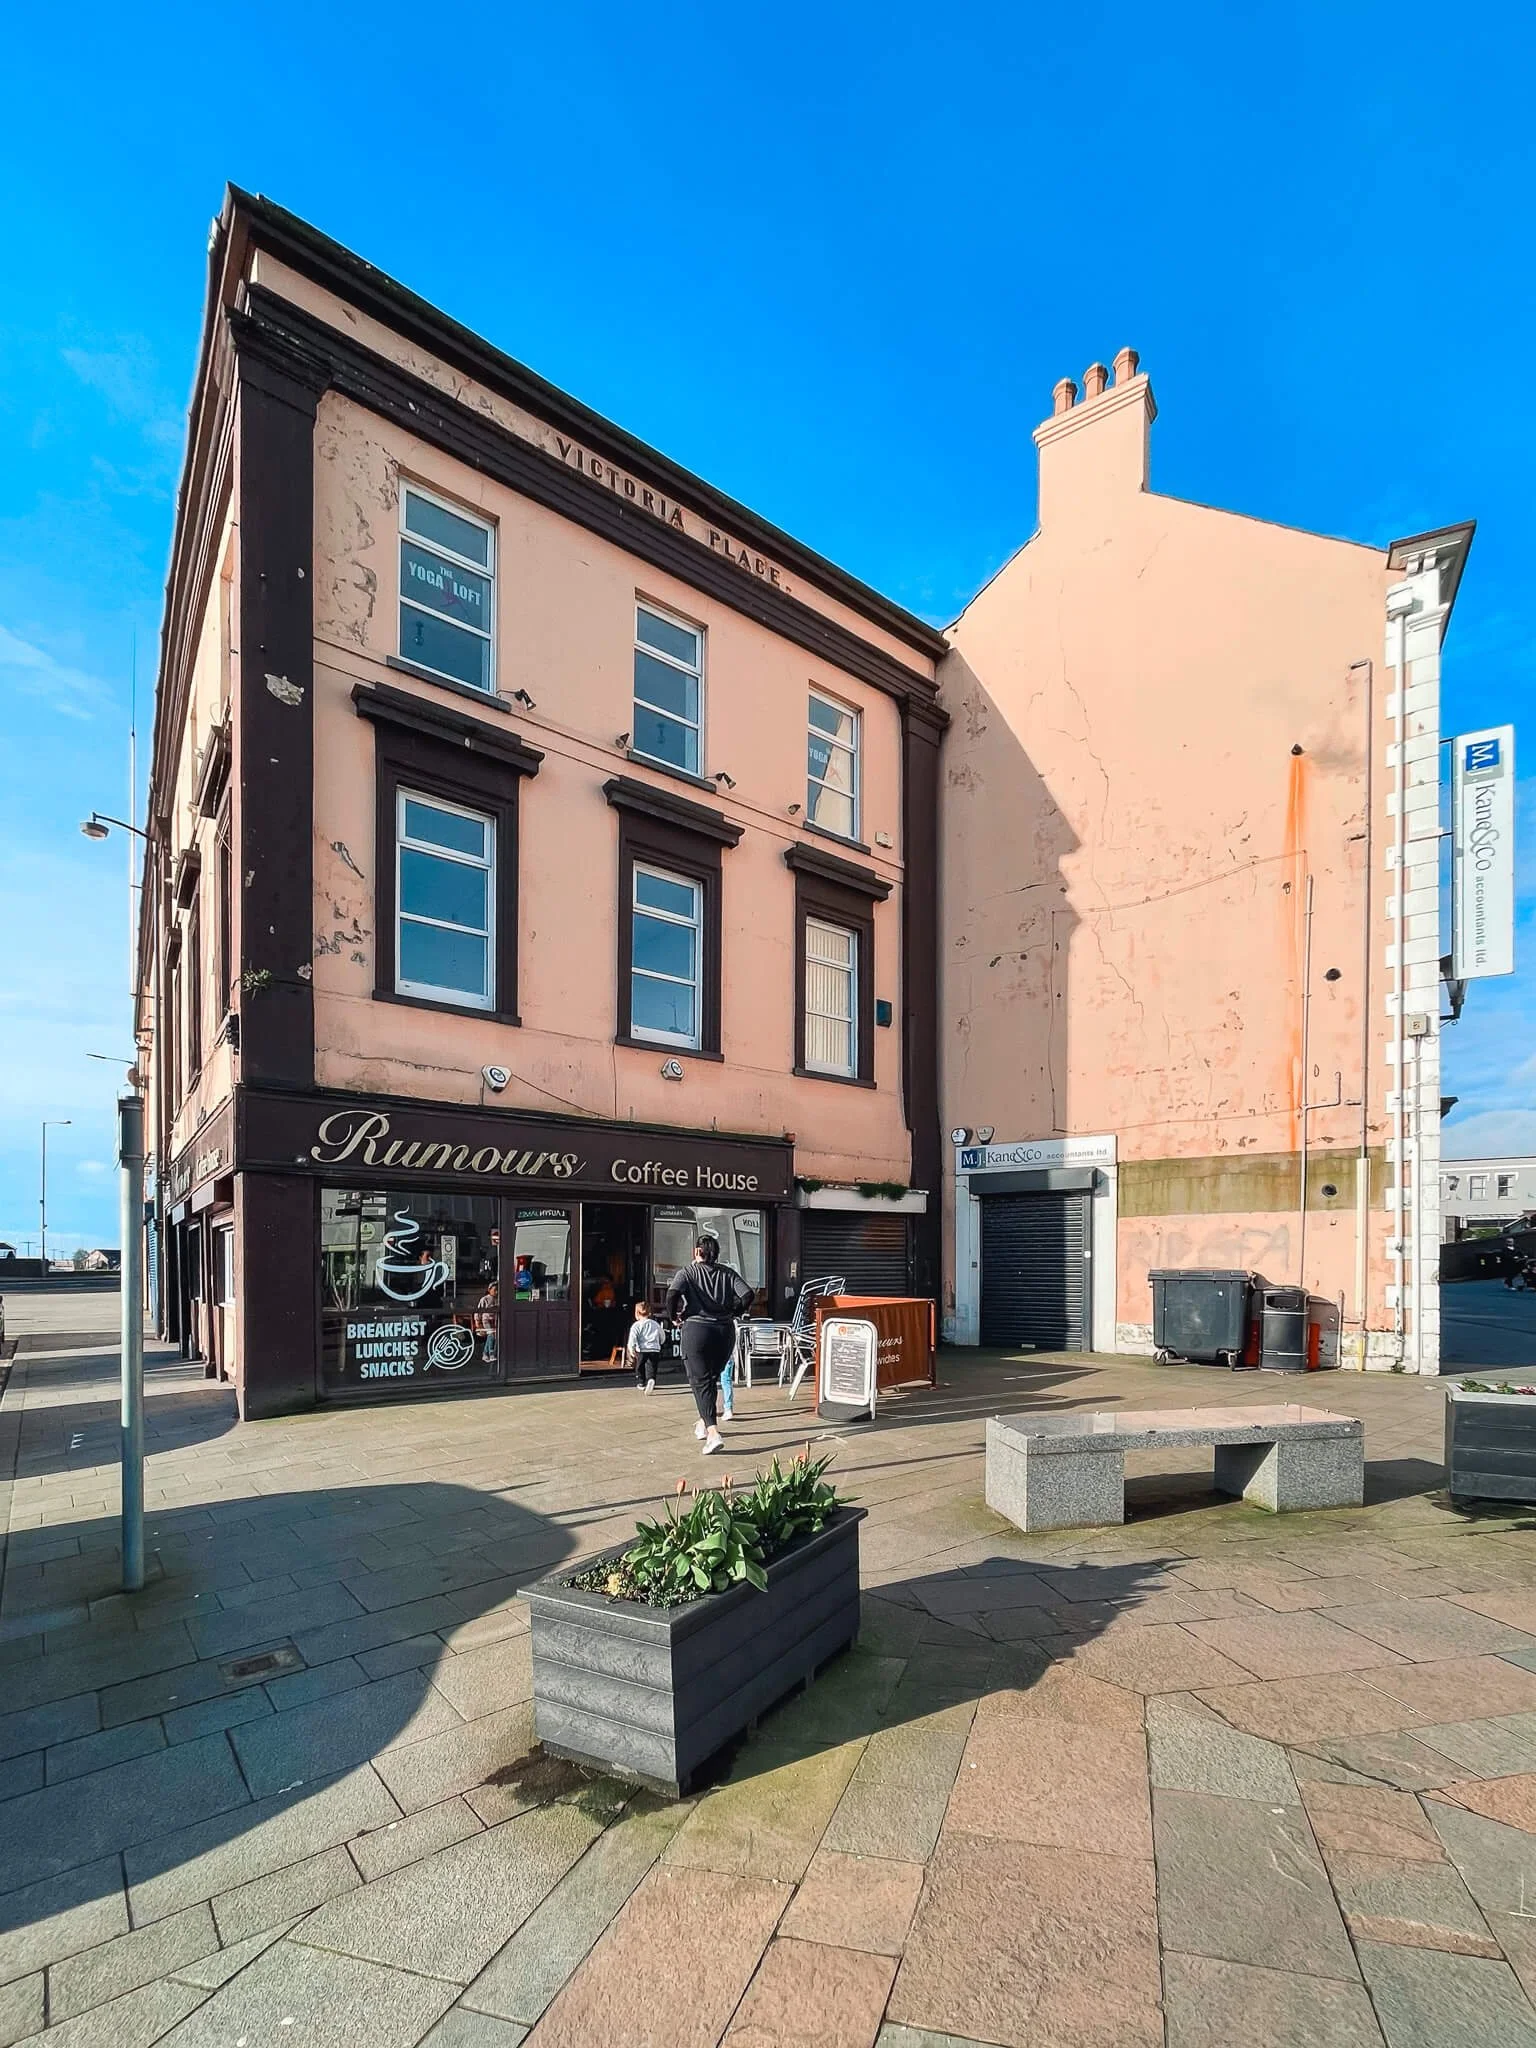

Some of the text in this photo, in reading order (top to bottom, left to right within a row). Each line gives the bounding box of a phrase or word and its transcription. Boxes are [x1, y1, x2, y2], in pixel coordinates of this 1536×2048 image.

[556, 437, 685, 532] VICTORIA
[408, 561, 480, 605] YOGA LOFT
[808, 747, 828, 764] YOGA
[1470, 783, 1499, 871] Kane&Co
[1475, 876, 1486, 945] accountants
[311, 1110, 759, 1191] Rumours Coffee House
[988, 1147, 1042, 1163] Kane&Co
[1047, 1150, 1094, 1159] accountants
[347, 1321, 427, 1339] BREAKFAST
[355, 1341, 419, 1359] LUNCHES
[360, 1360, 415, 1379] SNACKS
